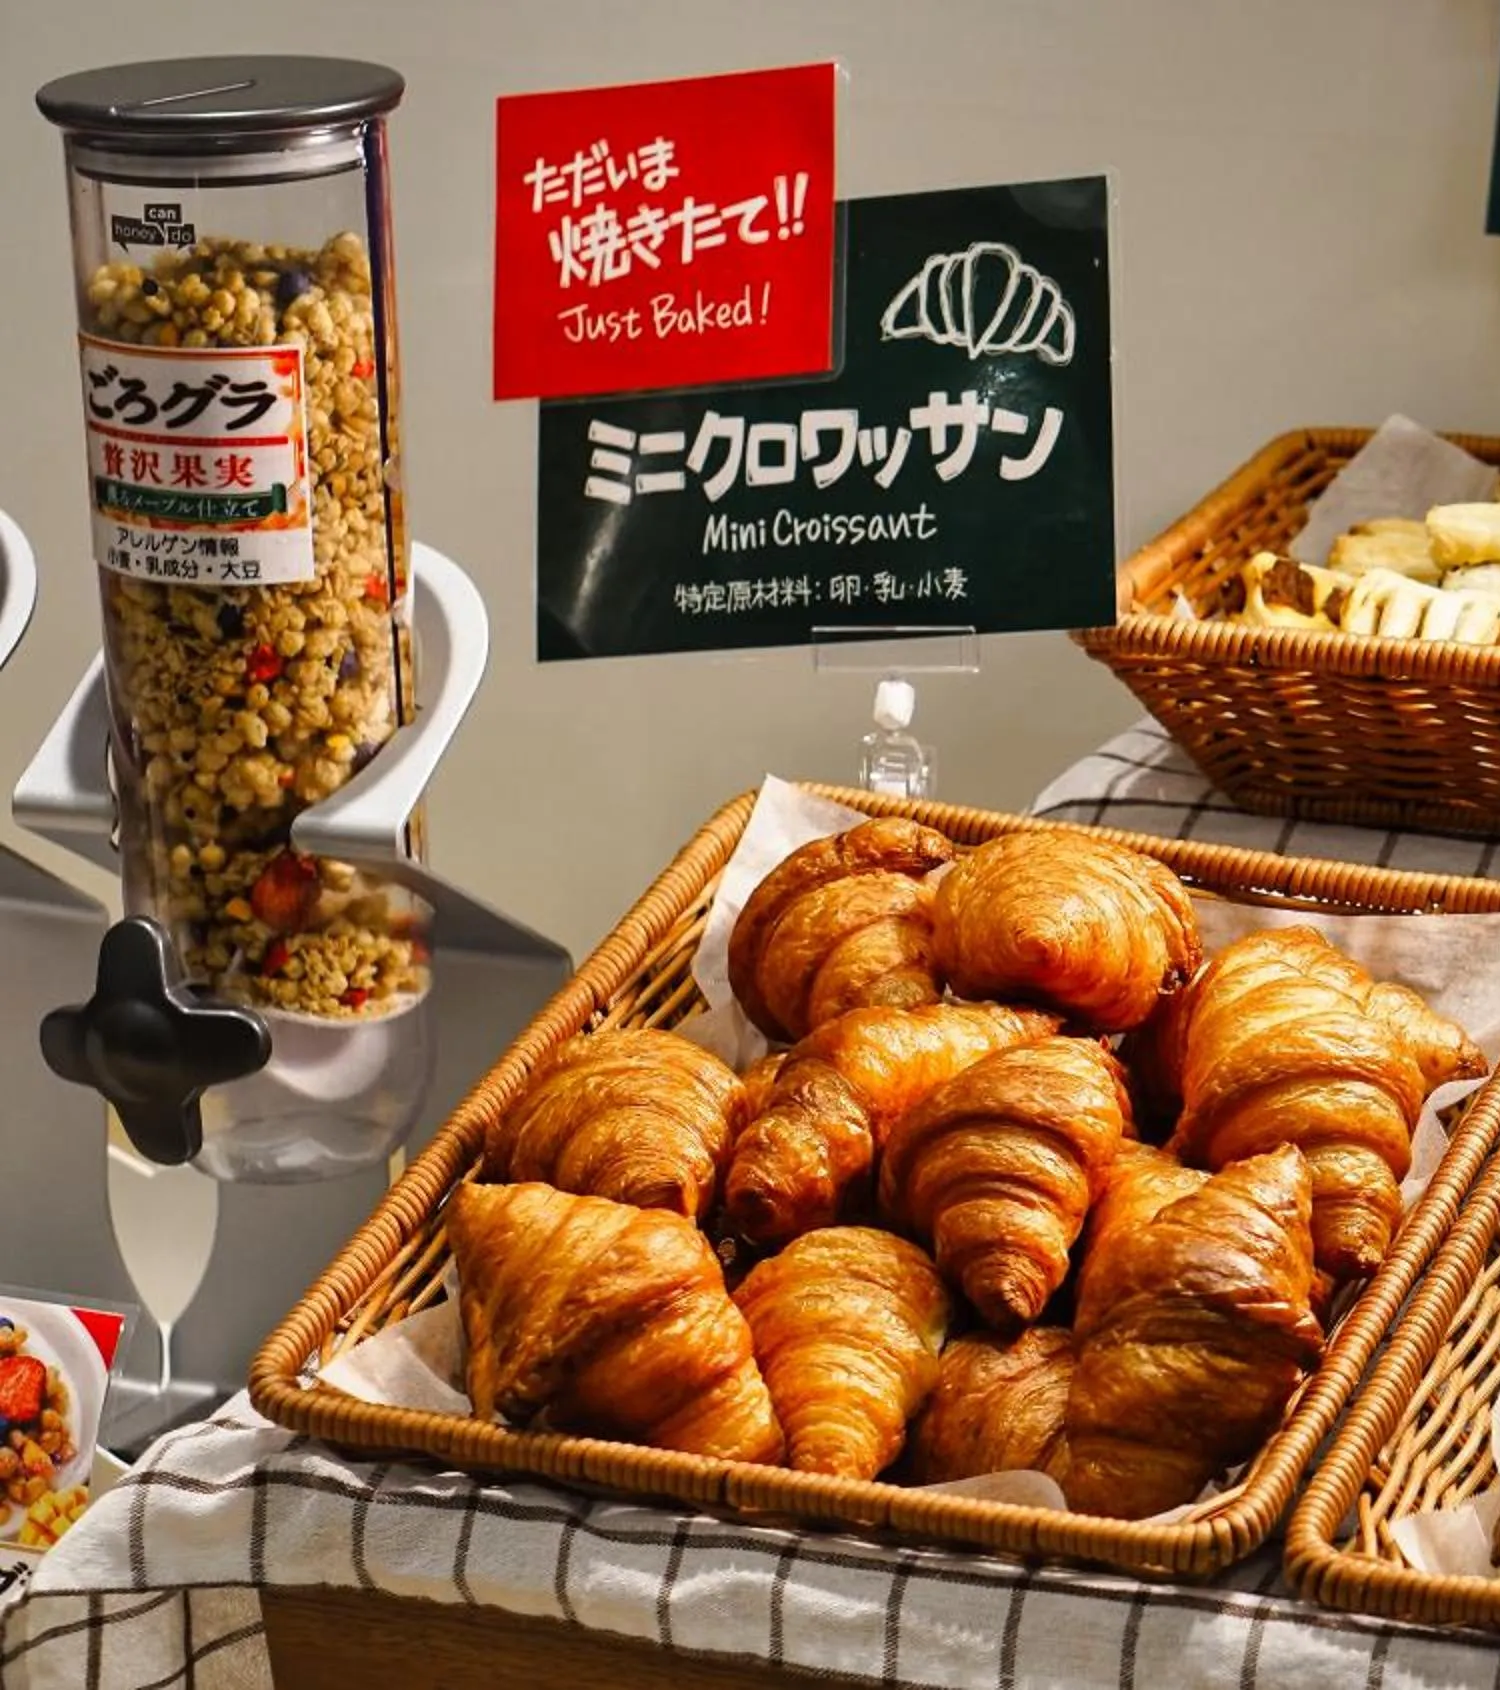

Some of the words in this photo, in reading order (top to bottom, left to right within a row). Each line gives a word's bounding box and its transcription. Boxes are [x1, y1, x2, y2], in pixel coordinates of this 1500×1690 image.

[523, 136, 680, 213] ただいま
[115, 222, 156, 242] honey
[171, 228, 192, 243] do
[148, 207, 177, 220] can
[557, 303, 643, 343] Just
[88, 364, 278, 430] ごろグラ
[102, 440, 256, 489] 贅沢果実
[584, 389, 1065, 506] ミニクロワッサン
[115, 526, 240, 557] アレルゲン情報
[702, 512, 767, 556] Mini
[773, 503, 938, 547] Croissant
